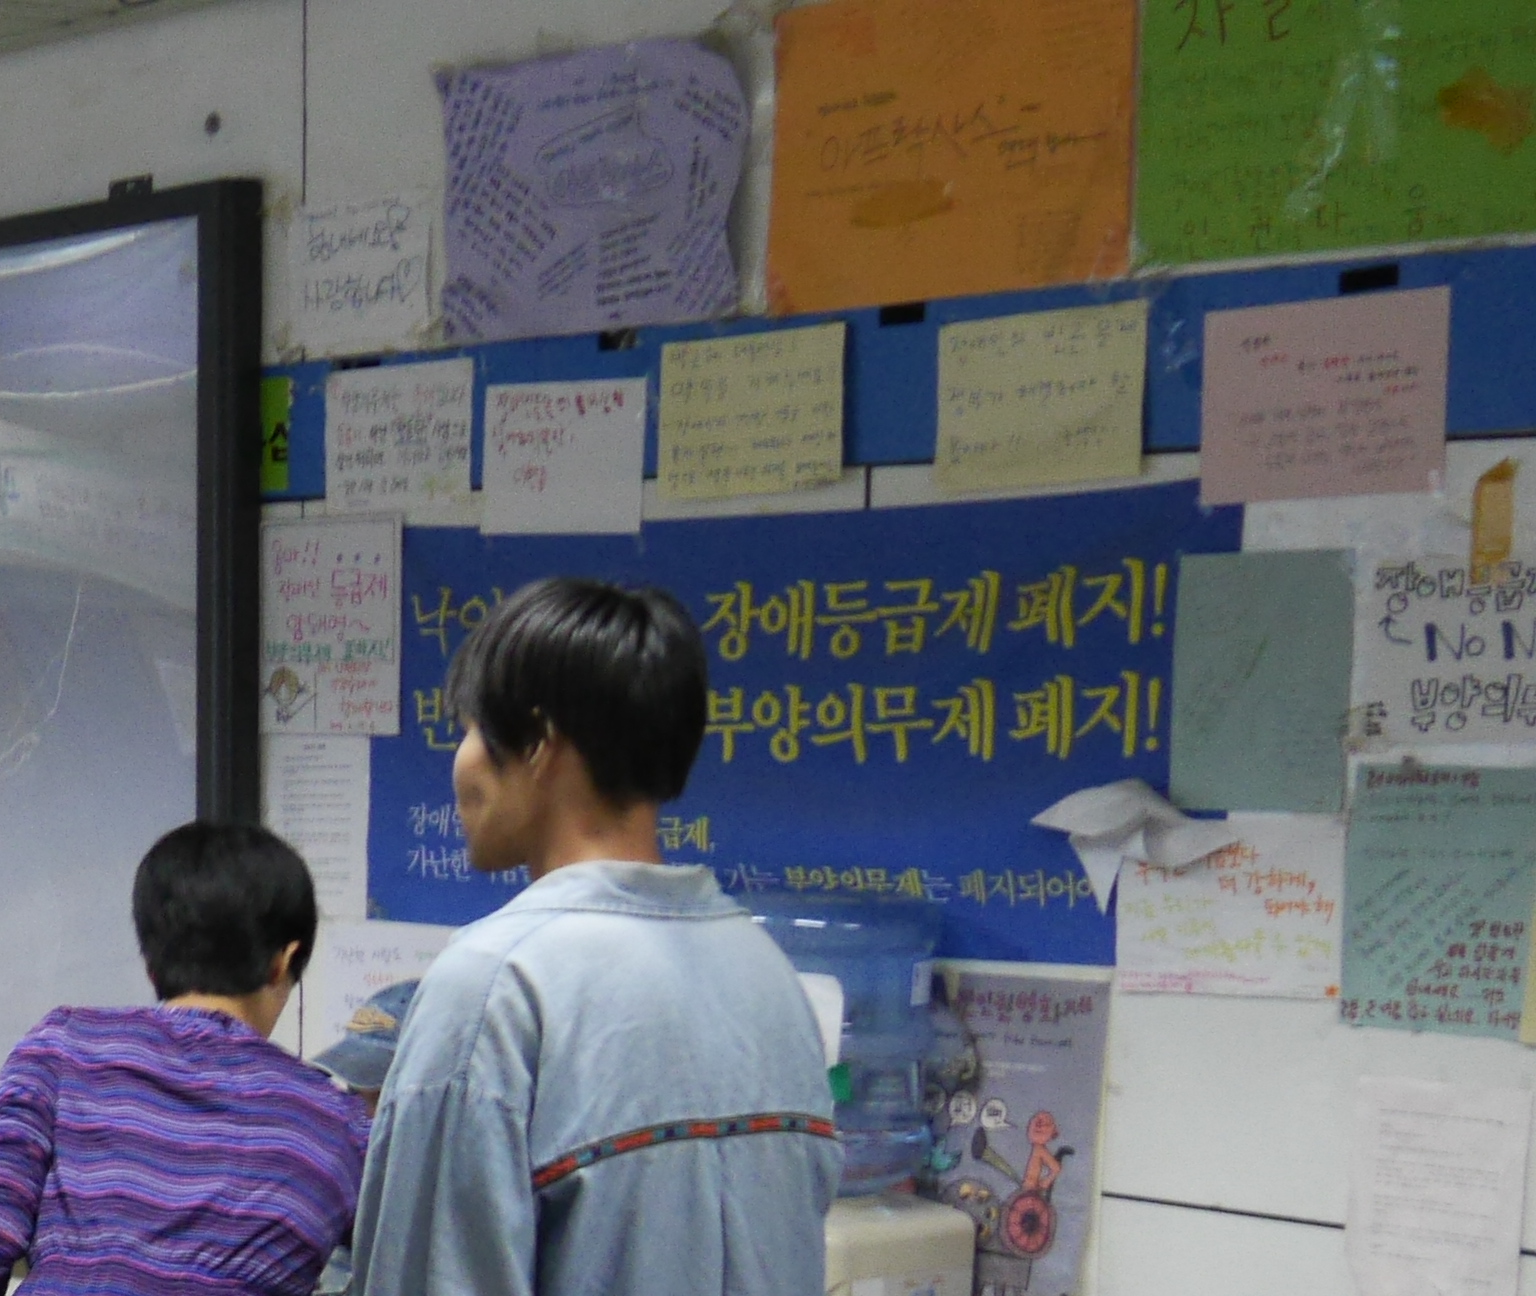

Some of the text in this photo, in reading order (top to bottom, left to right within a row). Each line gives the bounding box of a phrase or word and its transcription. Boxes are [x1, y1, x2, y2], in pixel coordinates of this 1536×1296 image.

[701, 568, 1001, 660] 장애등급제
[1007, 556, 1169, 650] 폐지!
[704, 679, 997, 765] 부양의무제
[1008, 669, 1164, 762] 폐지!
[407, 845, 473, 883] 가난한
